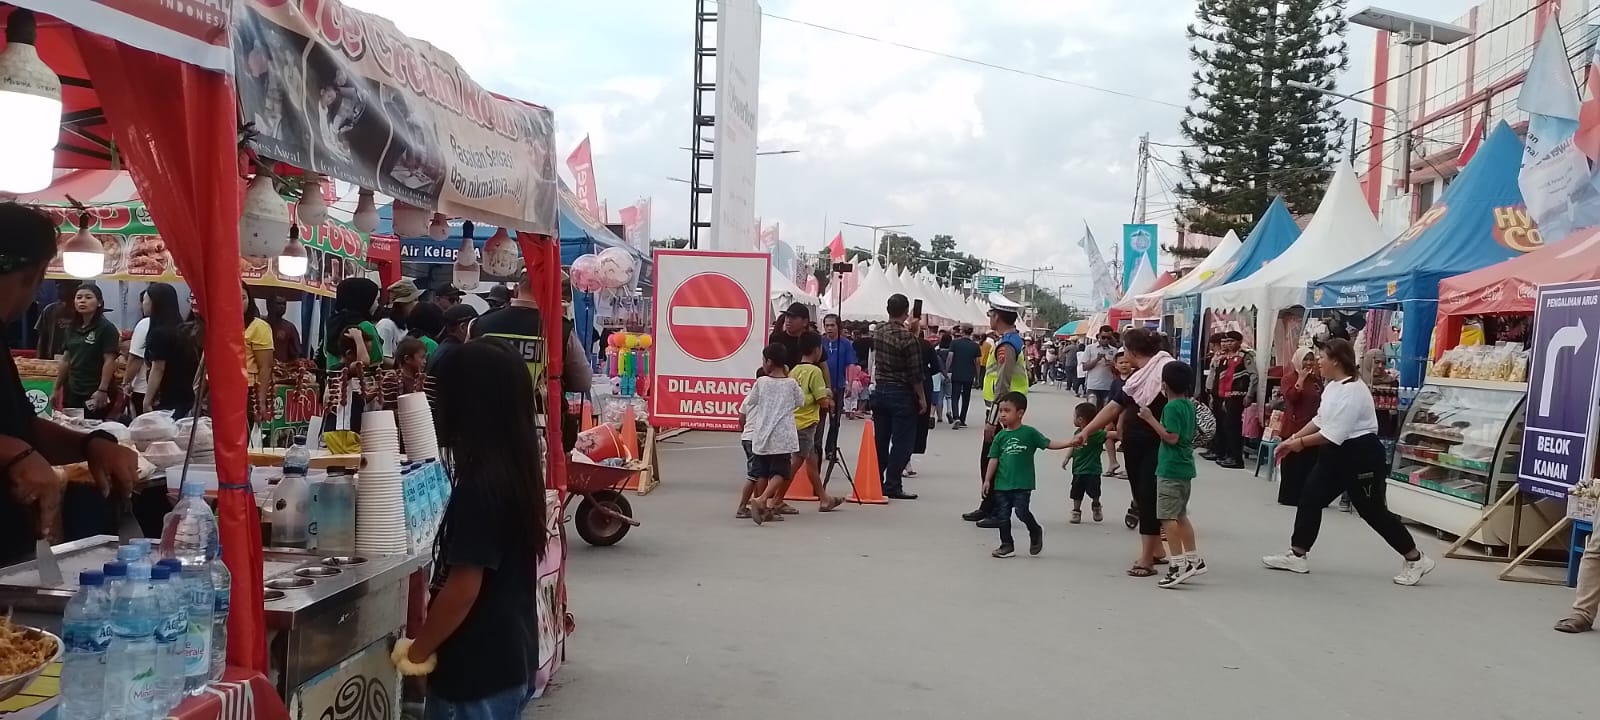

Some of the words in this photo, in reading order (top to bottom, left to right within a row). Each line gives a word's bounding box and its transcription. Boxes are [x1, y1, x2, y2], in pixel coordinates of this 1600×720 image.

[363, 13, 464, 117] Cream
[273, 143, 302, 164] Awal
[449, 133, 487, 168] Rasakan
[485, 145, 513, 169] Sensasi
[450, 164, 467, 196] dan
[400, 244, 421, 258] Air
[1547, 296, 1582, 308] PENGALIHAN
[1582, 295, 1598, 306] ARUS
[668, 379, 752, 396] DILARANG
[680, 400, 739, 415] MASUK
[1537, 436, 1571, 456] BELOK
[1533, 459, 1569, 480] KANAN
